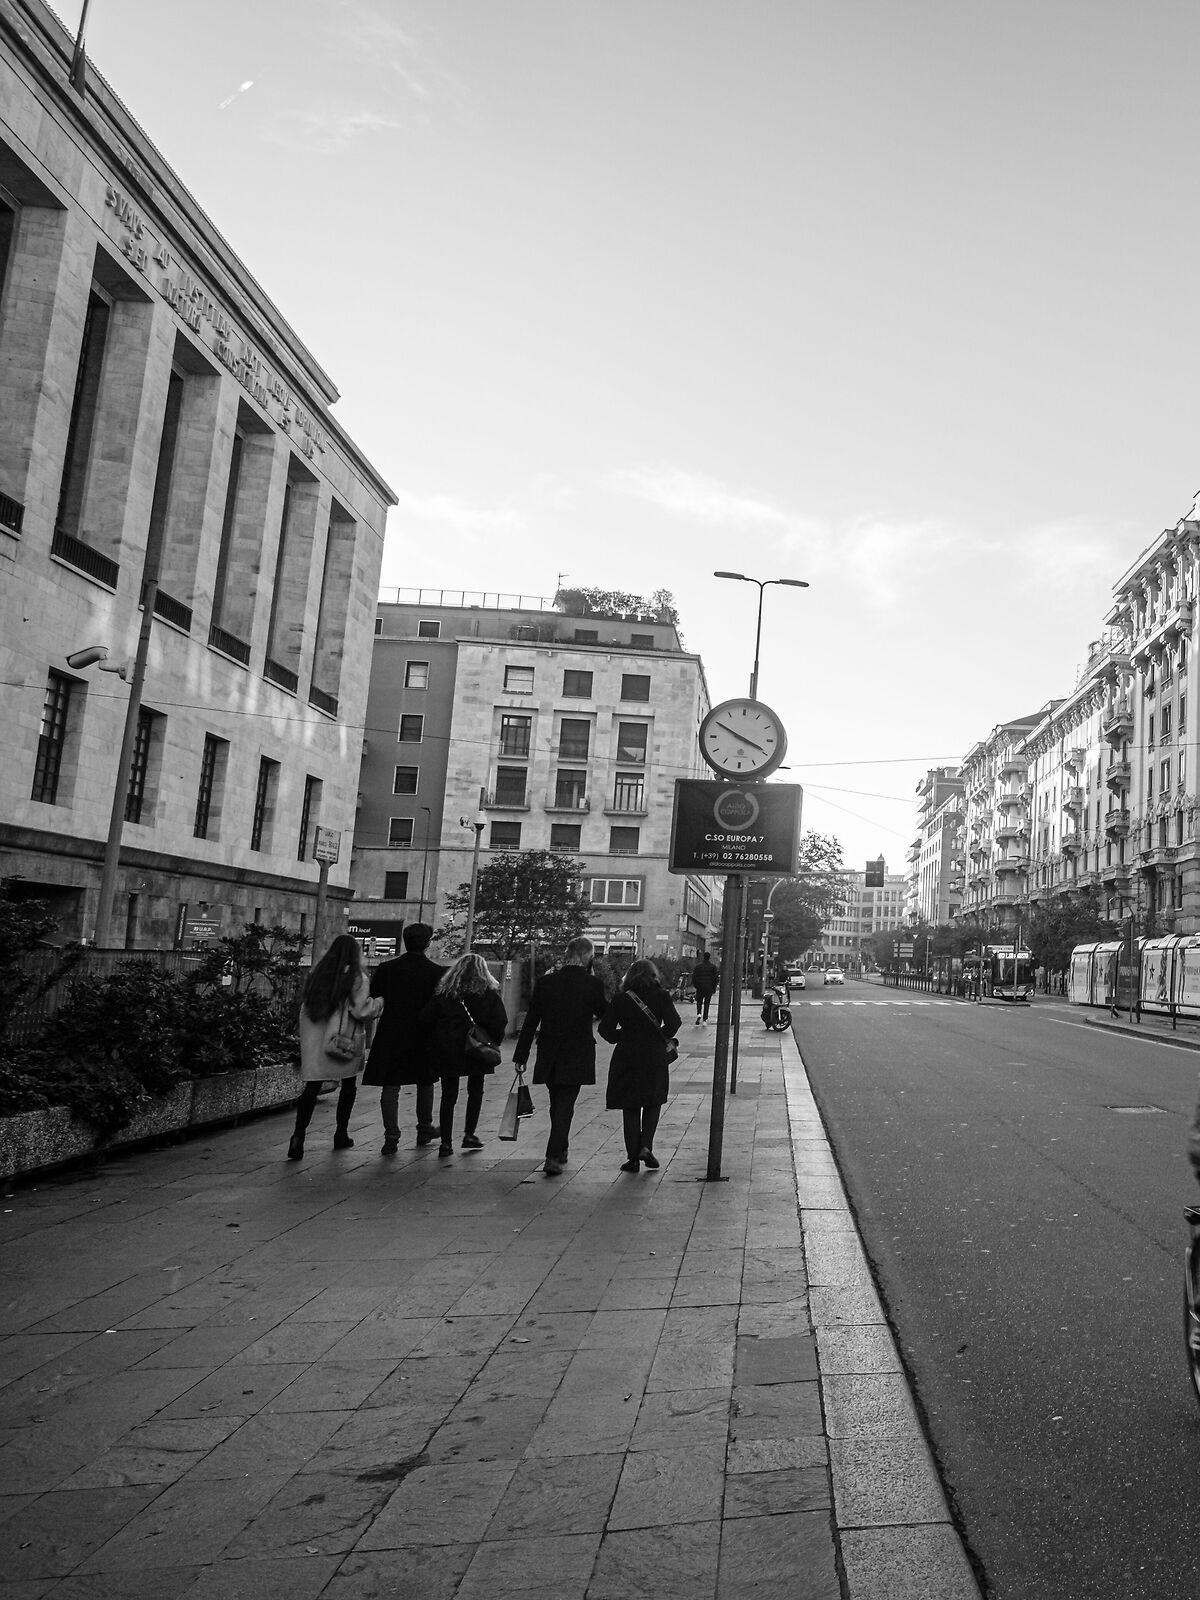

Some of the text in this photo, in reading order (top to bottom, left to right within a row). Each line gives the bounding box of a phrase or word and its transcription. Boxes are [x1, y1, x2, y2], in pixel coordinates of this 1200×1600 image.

[726, 834, 757, 843] EUROPA
[701, 852, 719, 860] (+39)
[722, 852, 733, 860] 02
[735, 853, 773, 861] 76280558
